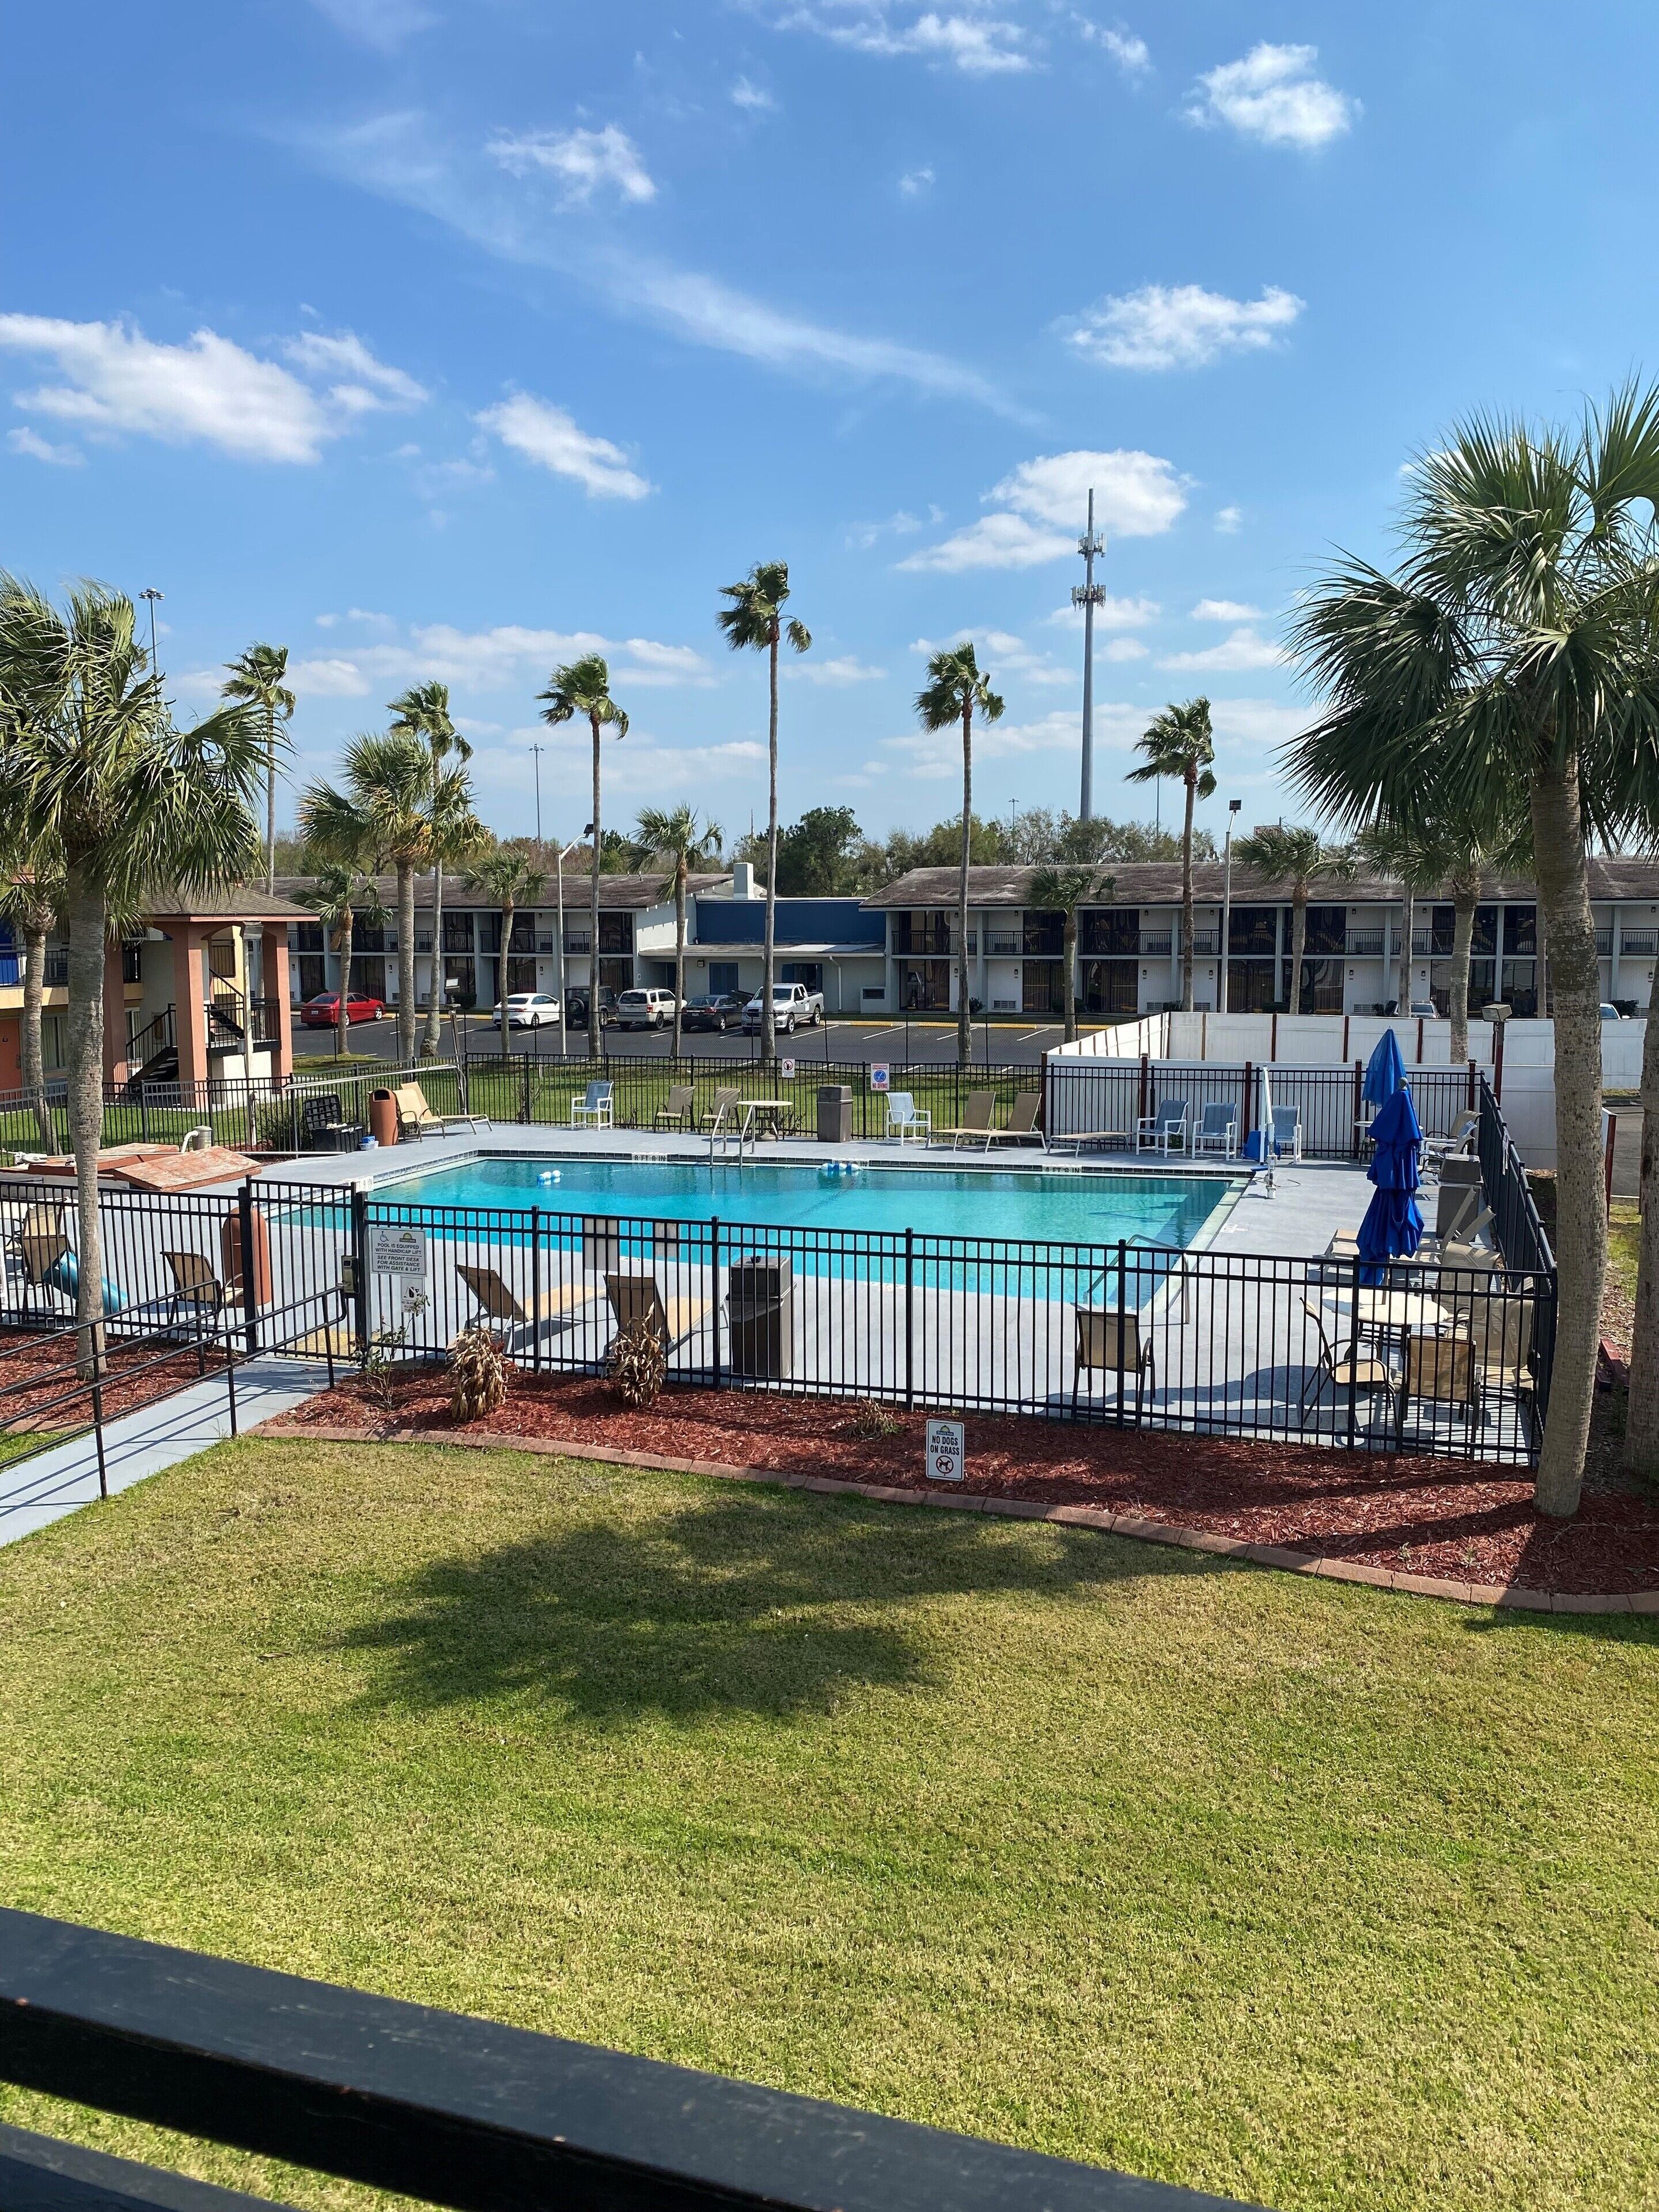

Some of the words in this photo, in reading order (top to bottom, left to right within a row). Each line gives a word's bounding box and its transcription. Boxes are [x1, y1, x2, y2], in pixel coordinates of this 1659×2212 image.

[931, 1435, 940, 1444] NO
[942, 1436, 959, 1446] DOGS
[930, 1444, 938, 1453] ON
[940, 1445, 960, 1456] GRASS
